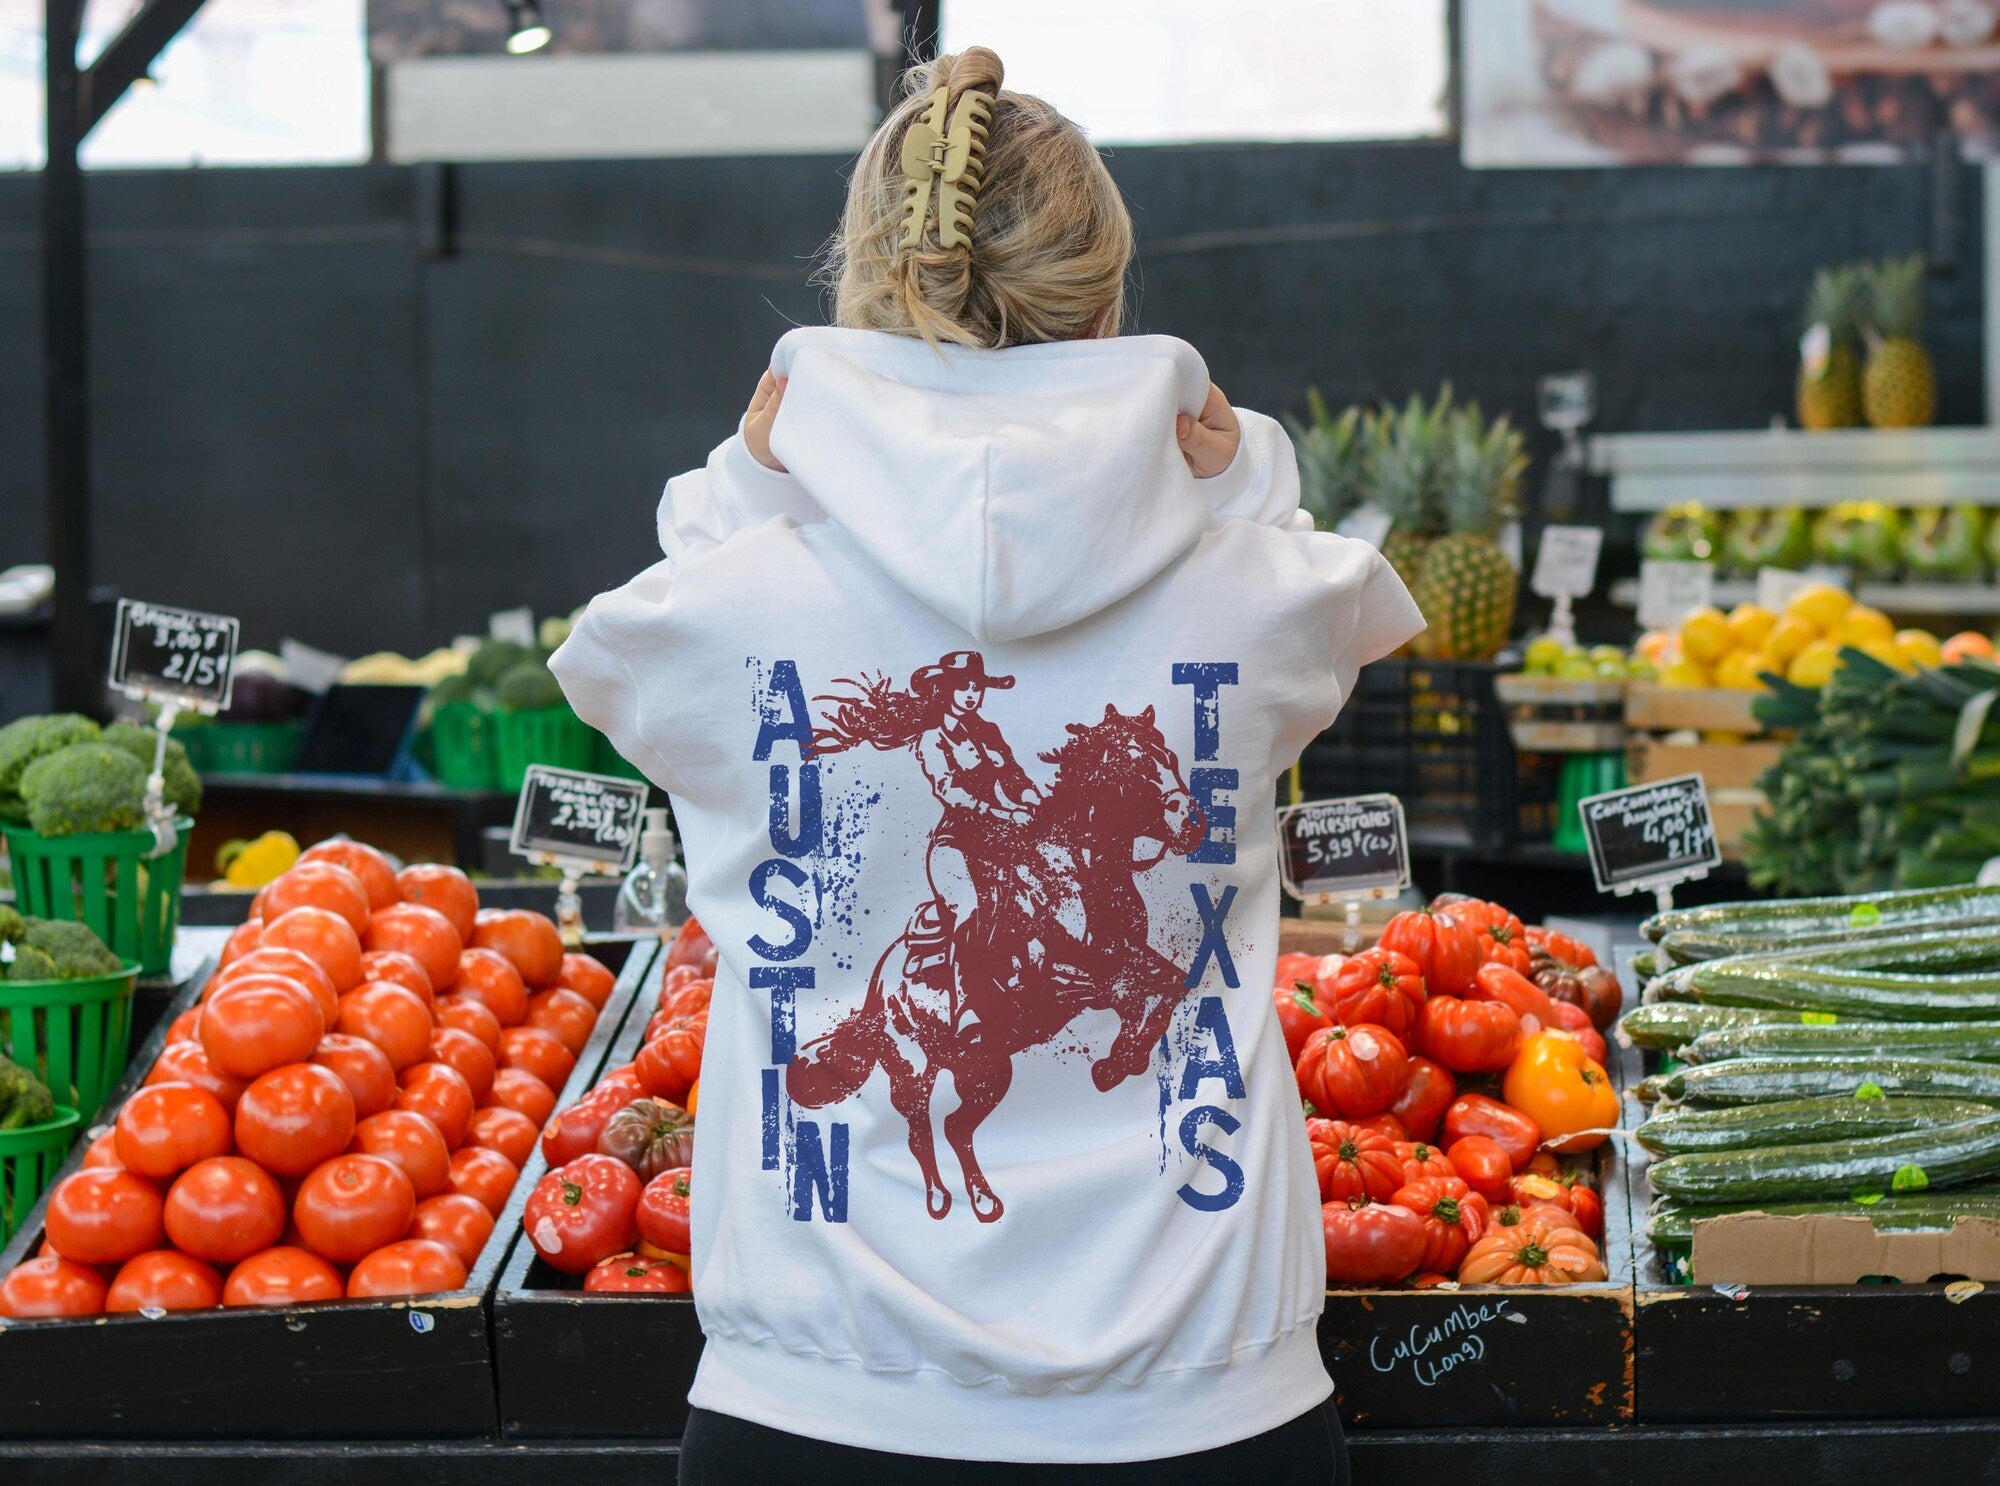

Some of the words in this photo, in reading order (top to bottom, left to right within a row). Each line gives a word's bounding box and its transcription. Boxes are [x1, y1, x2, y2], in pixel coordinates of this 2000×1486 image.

[746, 659, 850, 1224] AUSTIN
[1172, 662, 1247, 1212] TEXAS
[1296, 811, 1391, 838] Ancestrales
